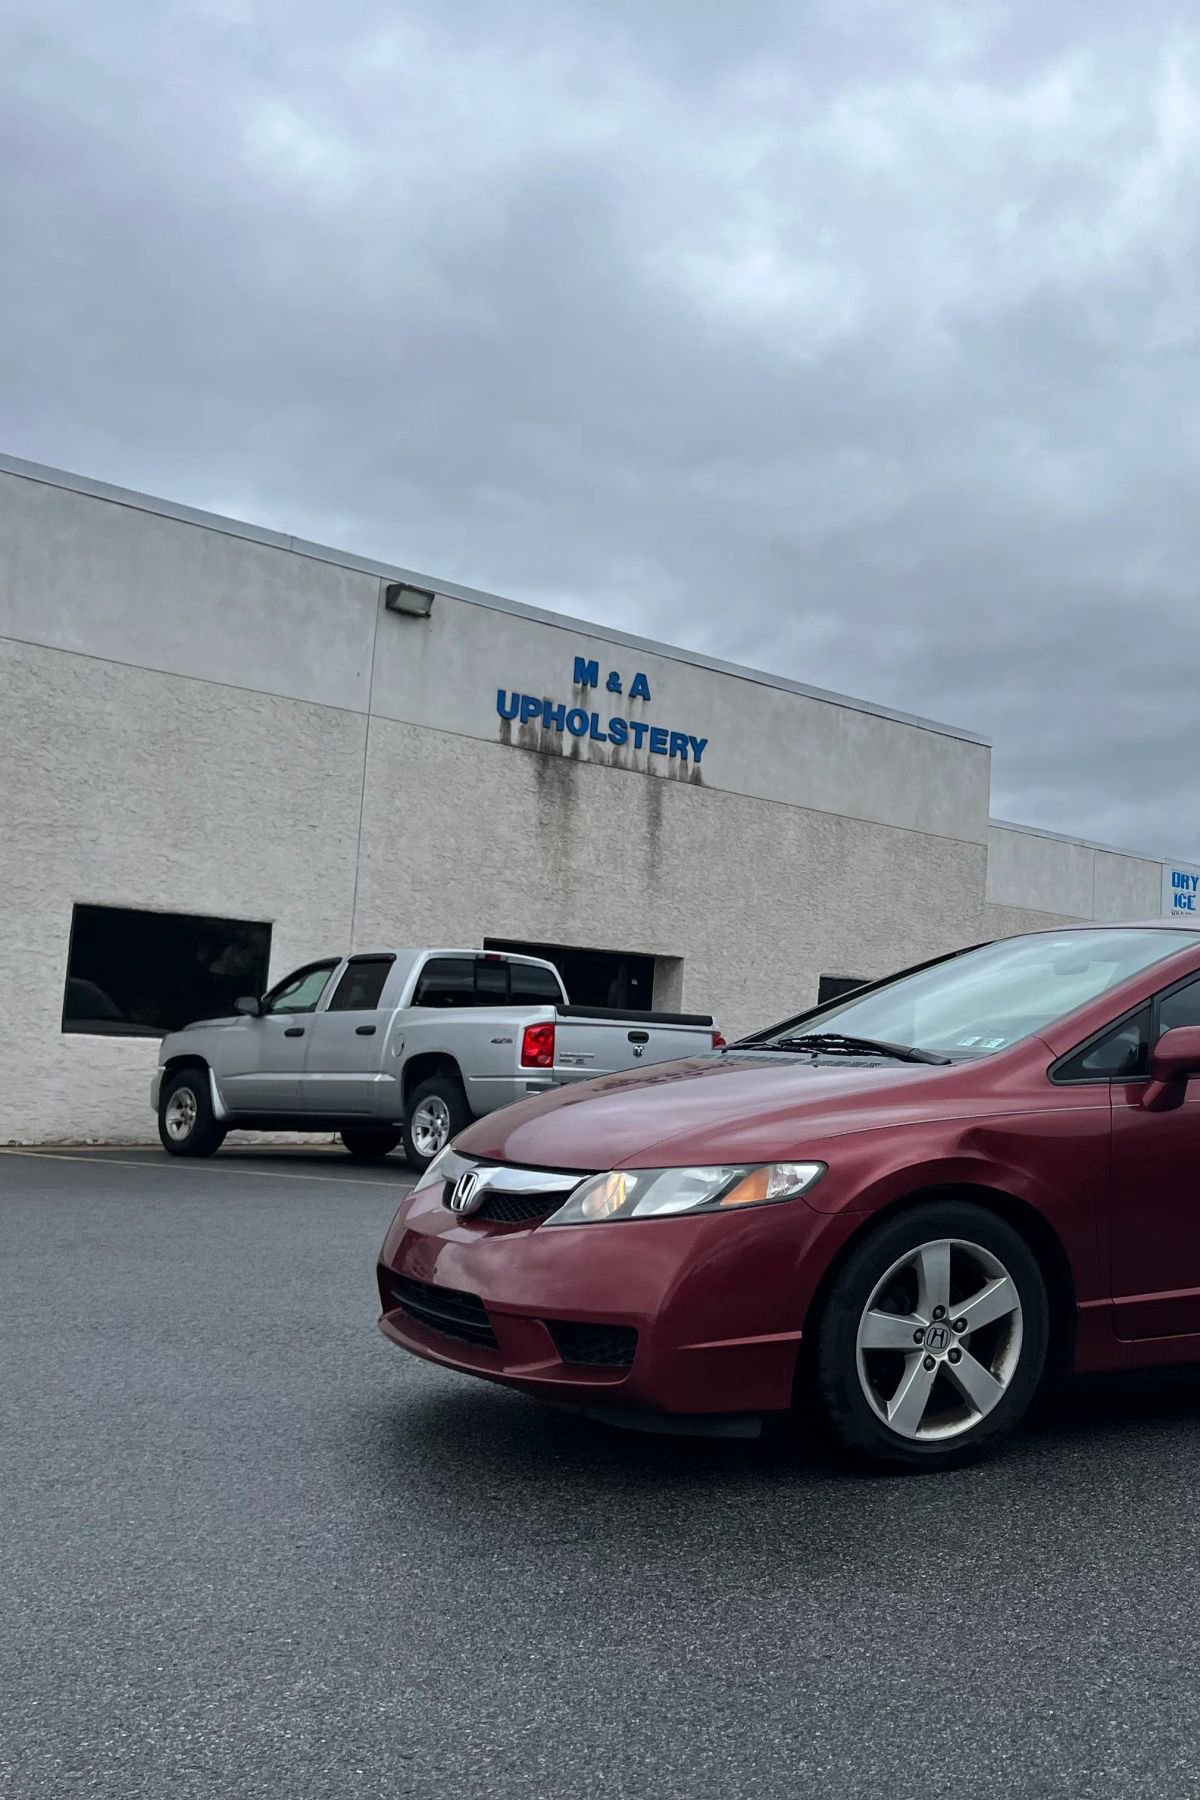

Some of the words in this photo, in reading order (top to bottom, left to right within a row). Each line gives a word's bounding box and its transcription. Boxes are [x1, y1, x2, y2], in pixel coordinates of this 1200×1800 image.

[573, 656, 599, 688] M
[606, 671, 622, 694] &
[628, 672, 651, 701] A
[496, 689, 708, 763] UPHOLSTERY
[1171, 871, 1199, 892] DRY
[1173, 892, 1196, 911] ICE
